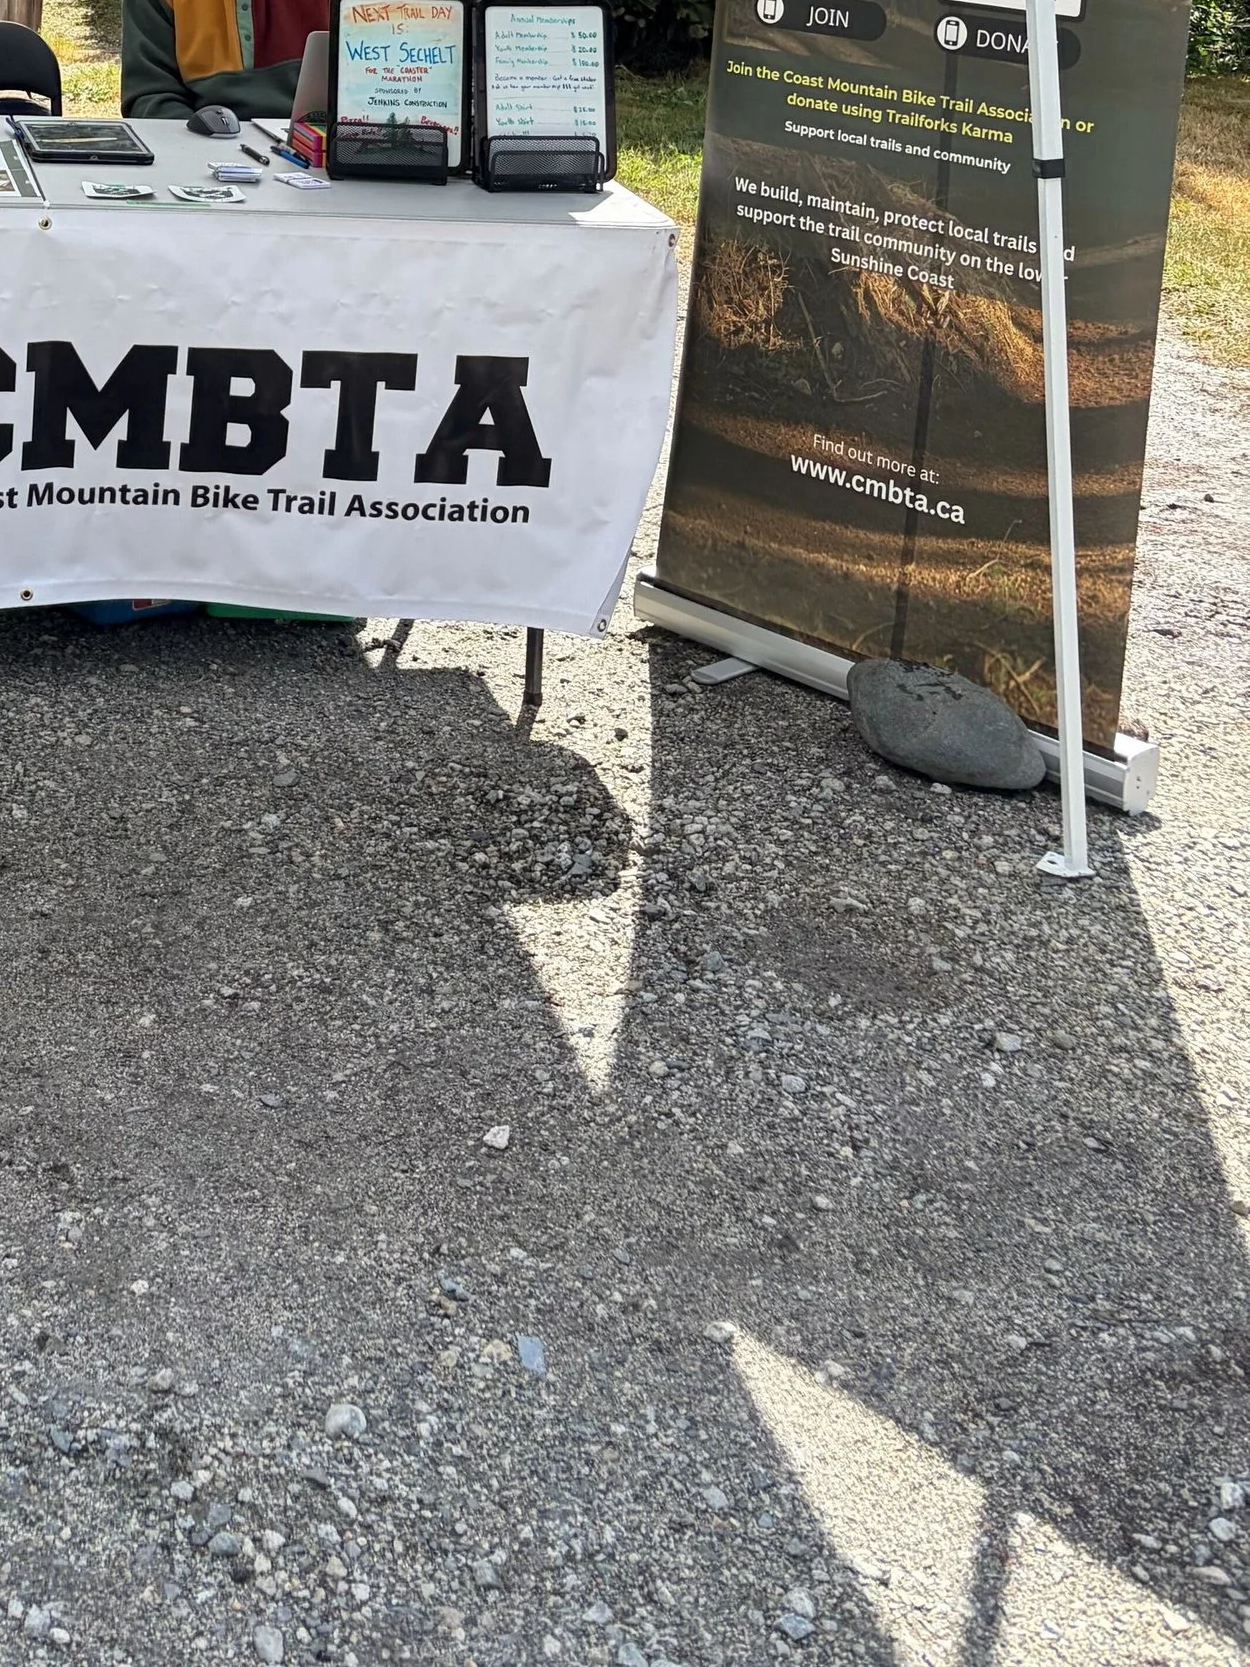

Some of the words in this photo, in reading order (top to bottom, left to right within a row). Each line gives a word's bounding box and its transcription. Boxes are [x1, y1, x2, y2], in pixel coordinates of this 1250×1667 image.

[351, 3, 391, 23] NEXT
[396, 3, 426, 19] TRAIL
[431, 5, 452, 20] DAY
[391, 22, 410, 35] IS:
[806, 3, 851, 28] JOIN
[345, 40, 391, 62] WEST
[399, 41, 456, 65] SECHELT
[365, 66, 378, 74] FOR
[382, 66, 394, 74] THE
[381, 75, 423, 83] MARATHON
[726, 60, 752, 77] Join
[756, 64, 780, 81] the
[783, 70, 824, 89] Coast
[827, 76, 898, 102] Mountain
[901, 89, 936, 108] Bike
[940, 95, 974, 115] Trail
[1075, 119, 1094, 134] or
[367, 96, 400, 107] JENKINS
[404, 98, 448, 109] CONSTRUCTION
[786, 93, 838, 113] donate
[841, 103, 883, 123] using
[886, 108, 958, 134] Trailforks
[961, 122, 1014, 144] Karma
[785, 120, 835, 141] Support
[837, 129, 867, 146] local
[870, 135, 903, 153] trails
[905, 141, 930, 158] and
[933, 147, 1011, 175] community
[735, 176, 758, 195] We
[760, 181, 803, 207] build,
[806, 192, 880, 223] maintain,
[883, 208, 945, 234] protect
[948, 220, 989, 244] local
[993, 231, 1038, 254] trails
[736, 203, 796, 229] support
[799, 215, 825, 234] the
[828, 221, 861, 243] trail
[863, 232, 956, 265] community
[959, 253, 981, 269] on
[985, 256, 1014, 276] the
[830, 247, 904, 278] Sunshine
[907, 265, 955, 289] Coast
[813, 433, 844, 456] Find
[848, 447, 873, 465] out
[876, 456, 916, 477] more
[919, 468, 940, 485] at:
[26, 482, 181, 508] Mountain
[189, 484, 259, 512] Bike
[266, 487, 336, 517] Trail
[344, 493, 531, 525] Association
[790, 454, 966, 525] www.cmbta.ca
